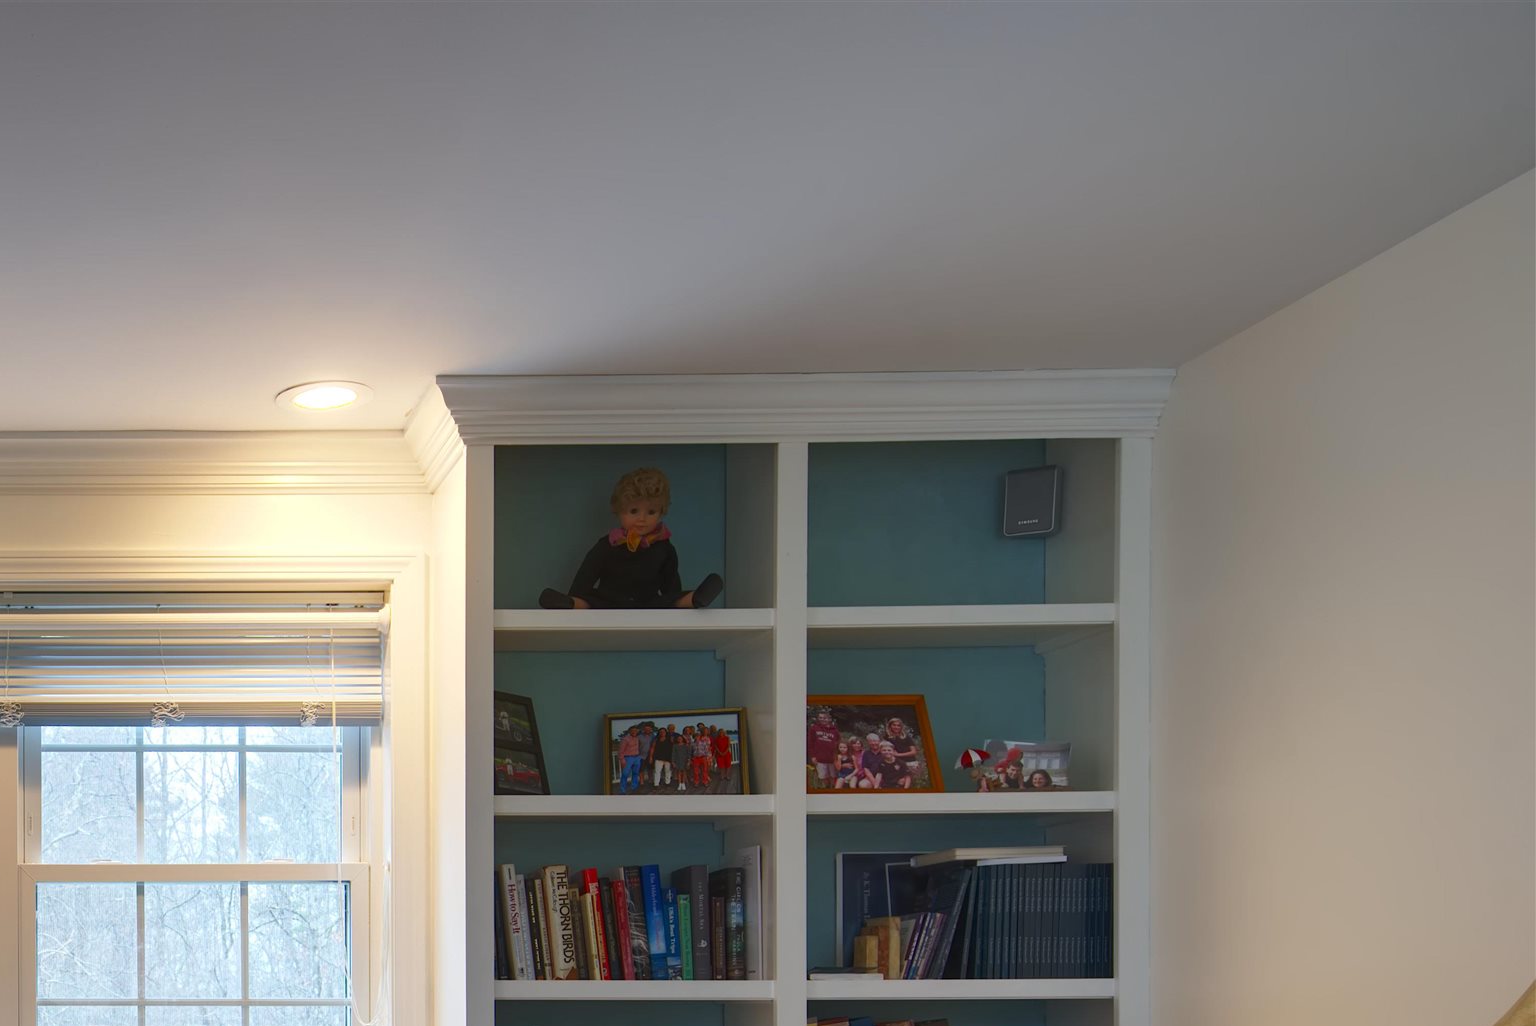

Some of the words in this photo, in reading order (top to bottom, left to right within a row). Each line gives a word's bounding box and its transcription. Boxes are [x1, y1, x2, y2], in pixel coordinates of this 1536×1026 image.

[557, 871, 567, 891] THE
[508, 884, 517, 902] How
[511, 902, 518, 911] to
[559, 893, 571, 931] THORN
[510, 911, 520, 927] Say
[563, 933, 575, 964] BIRDS
